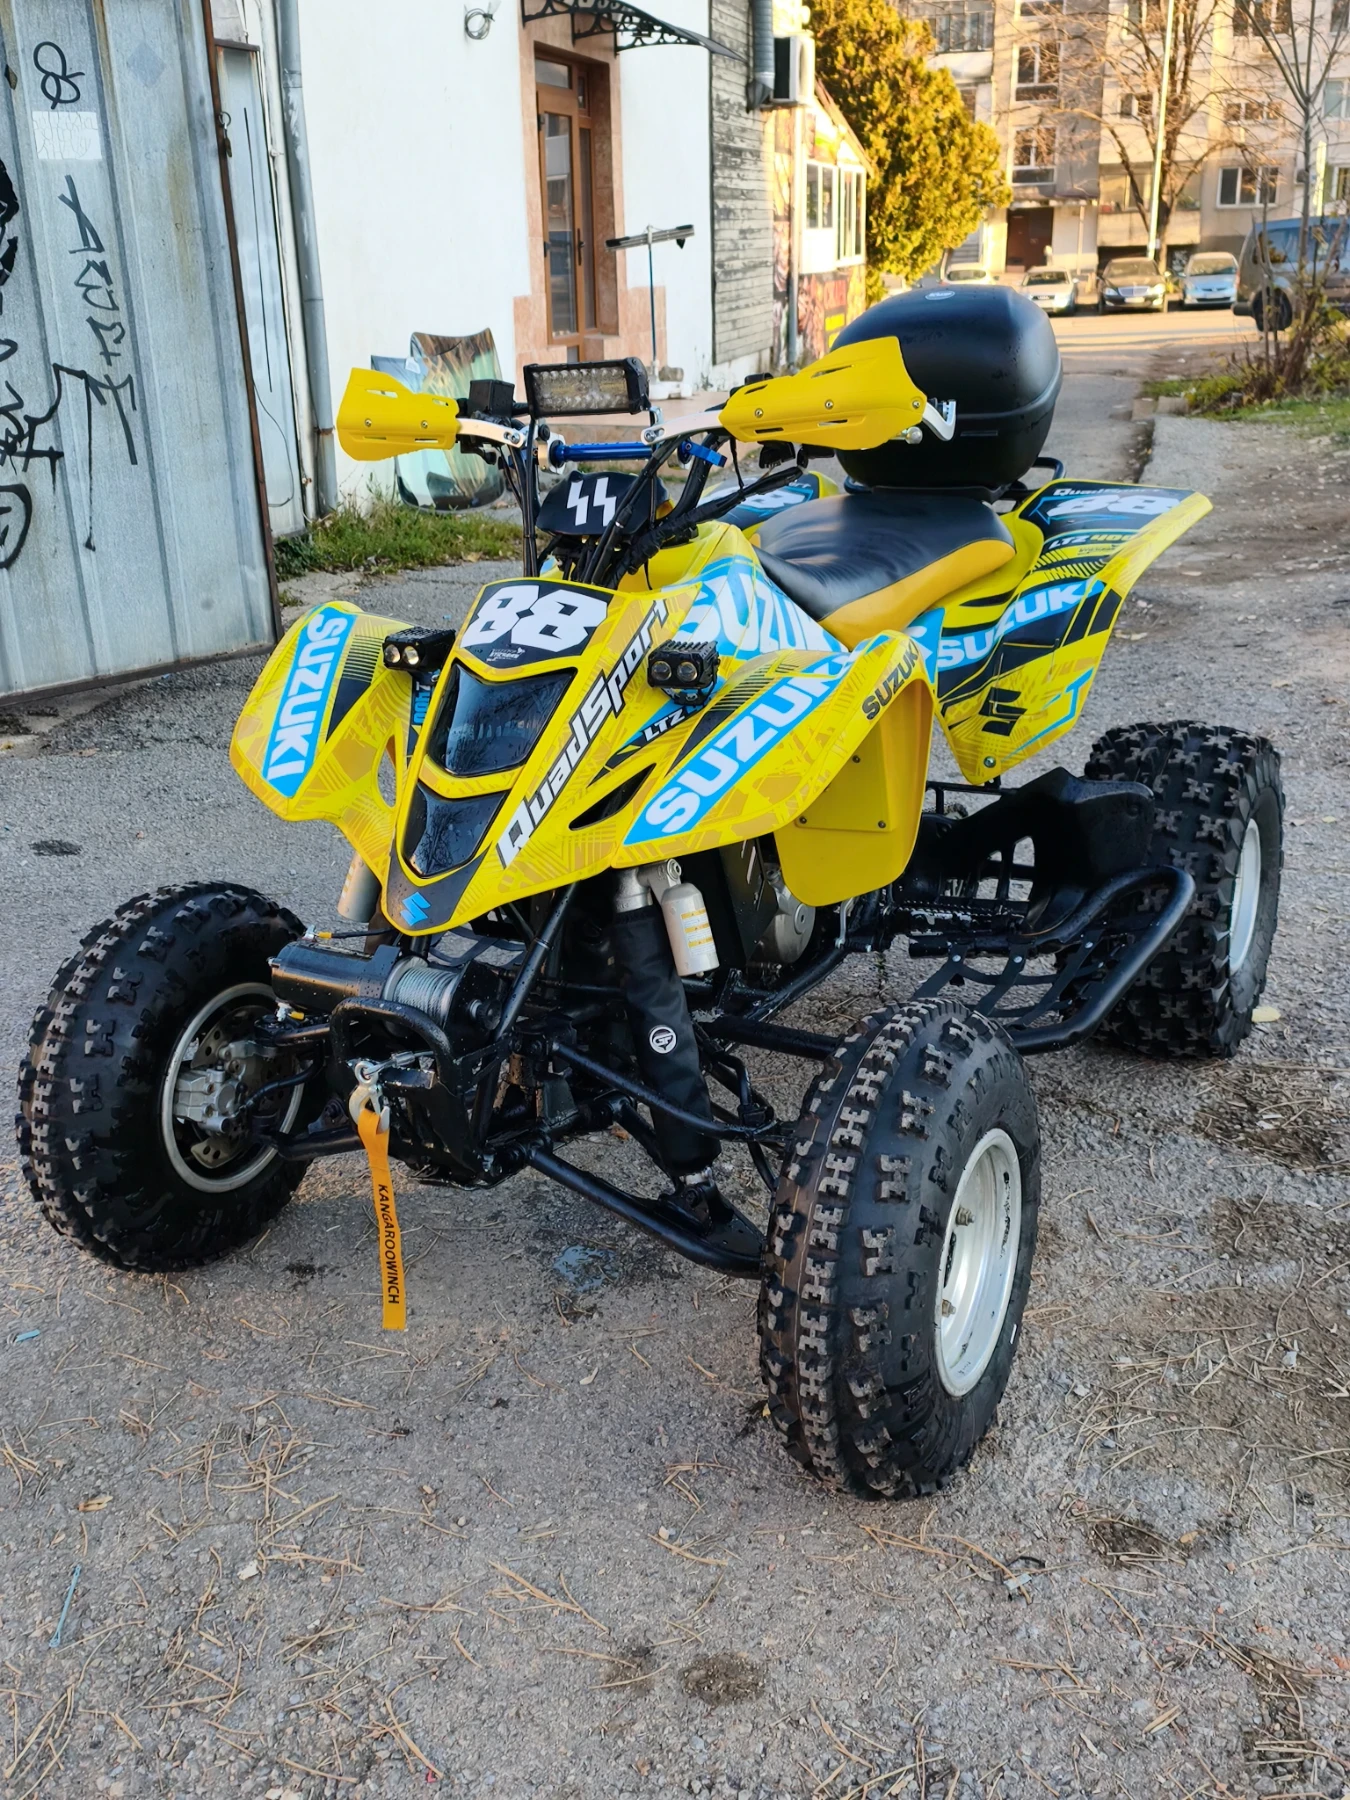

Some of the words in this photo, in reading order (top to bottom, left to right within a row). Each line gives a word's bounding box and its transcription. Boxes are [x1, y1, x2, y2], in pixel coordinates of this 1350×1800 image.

[460, 585, 608, 652] 88
[267, 613, 348, 781] SUZUKI
[496, 599, 669, 869] QuadSport
[644, 708, 686, 742] LTZ
[378, 1183, 400, 1304] KANGAROOWINCH
